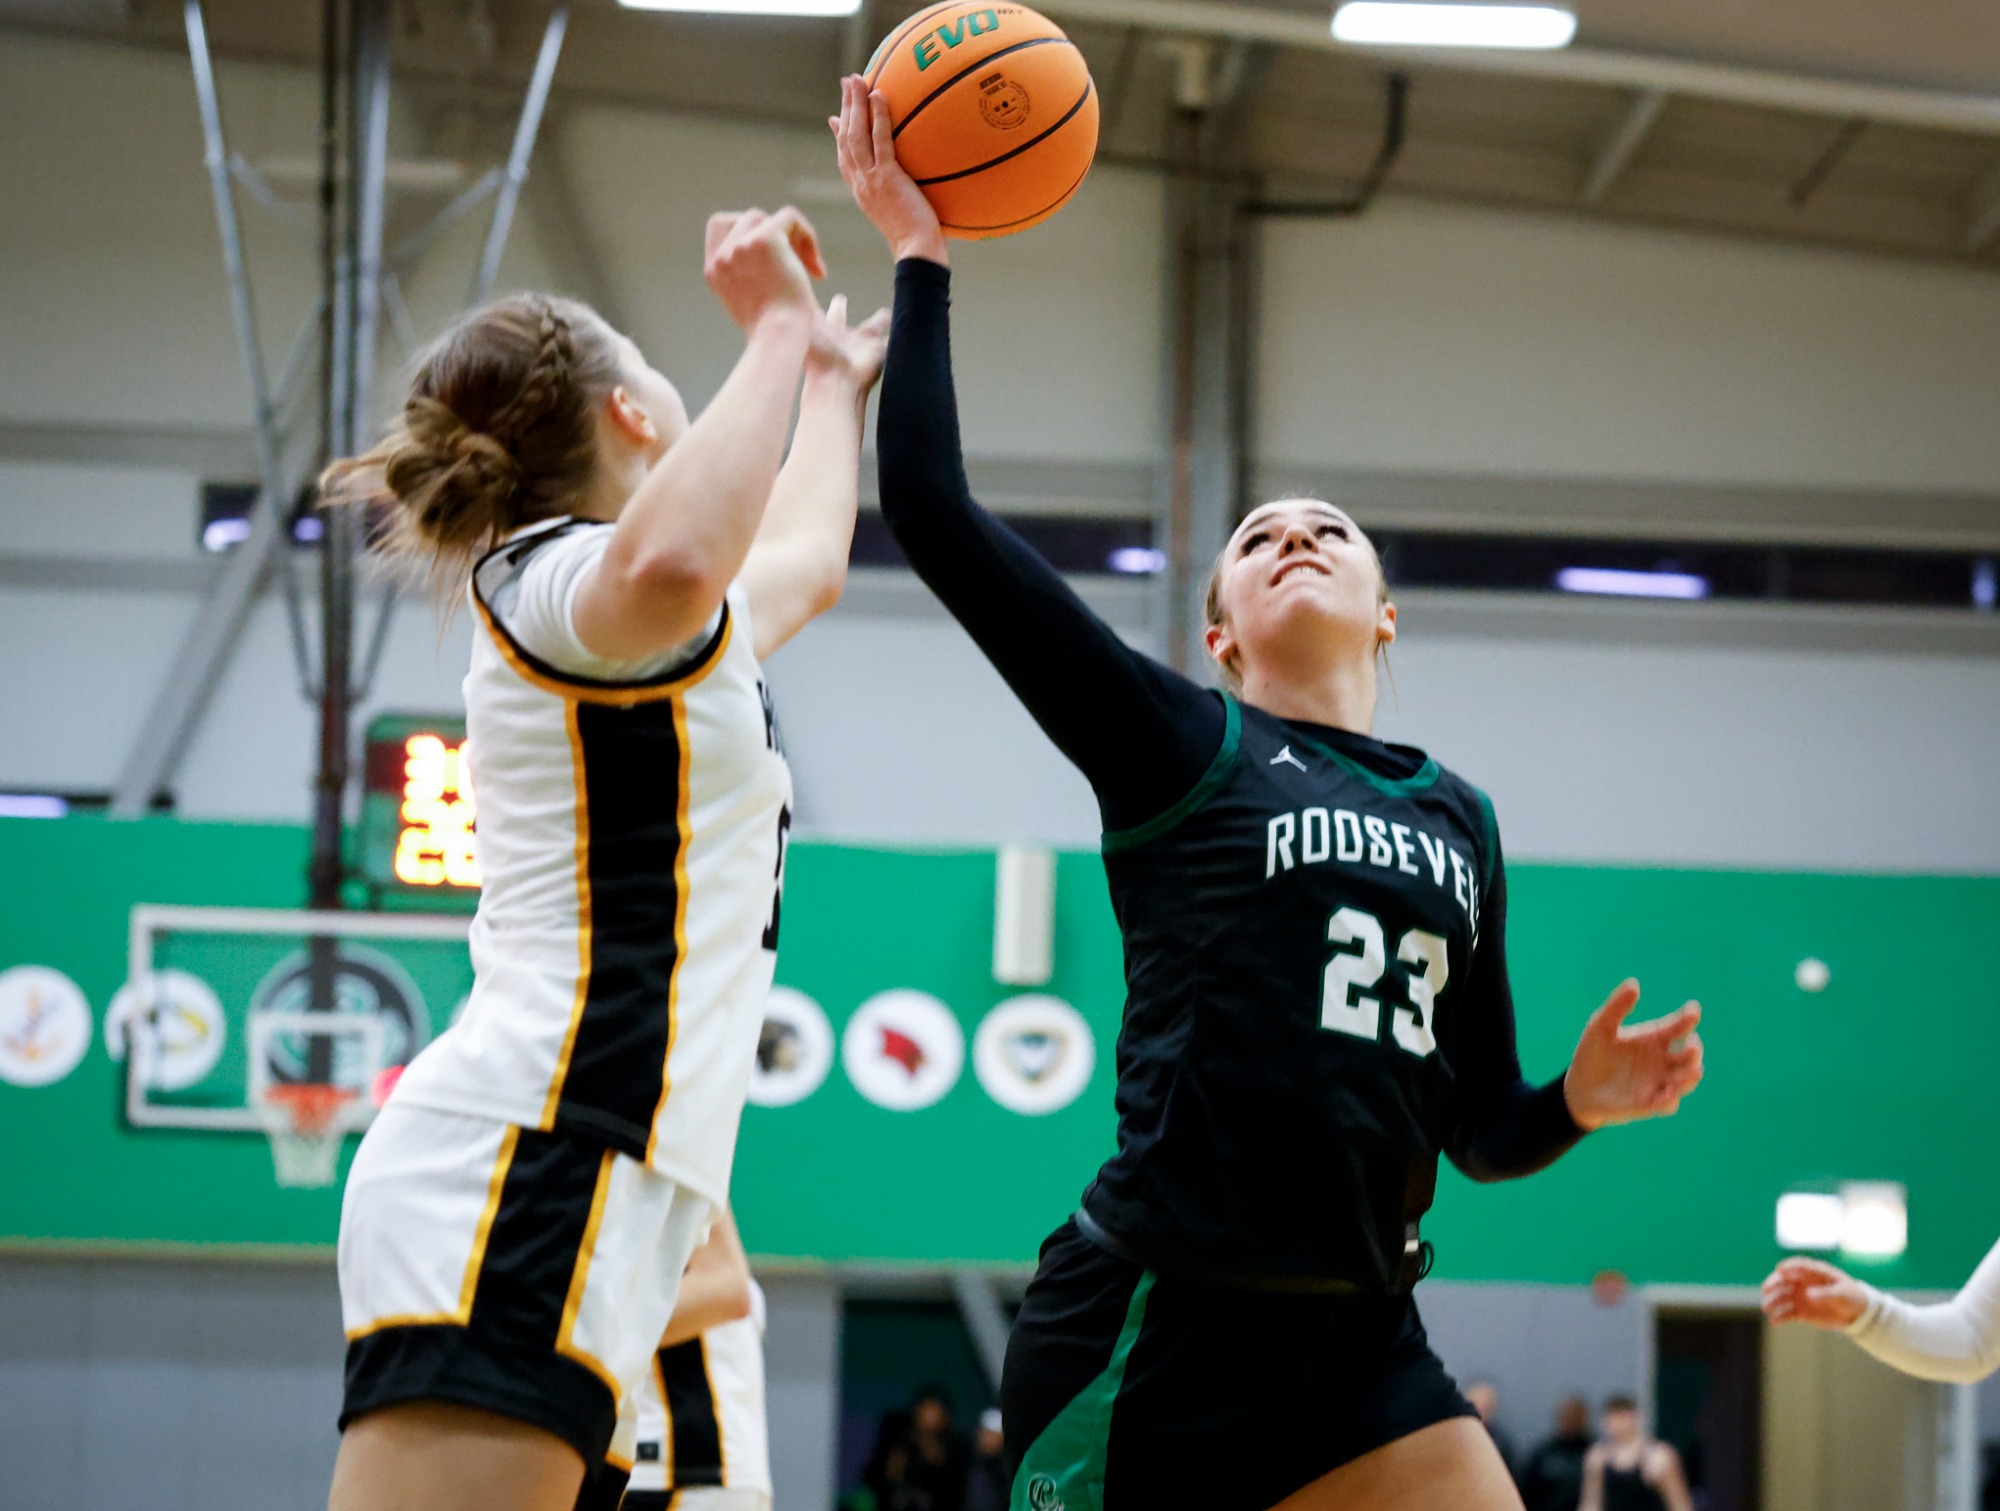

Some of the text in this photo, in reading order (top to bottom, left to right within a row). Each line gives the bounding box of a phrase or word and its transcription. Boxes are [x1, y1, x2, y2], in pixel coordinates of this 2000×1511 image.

[912, 8, 1000, 72] EVO
[1265, 806, 1479, 950] ROOSEVEL
[1320, 905, 1450, 1058] 23
